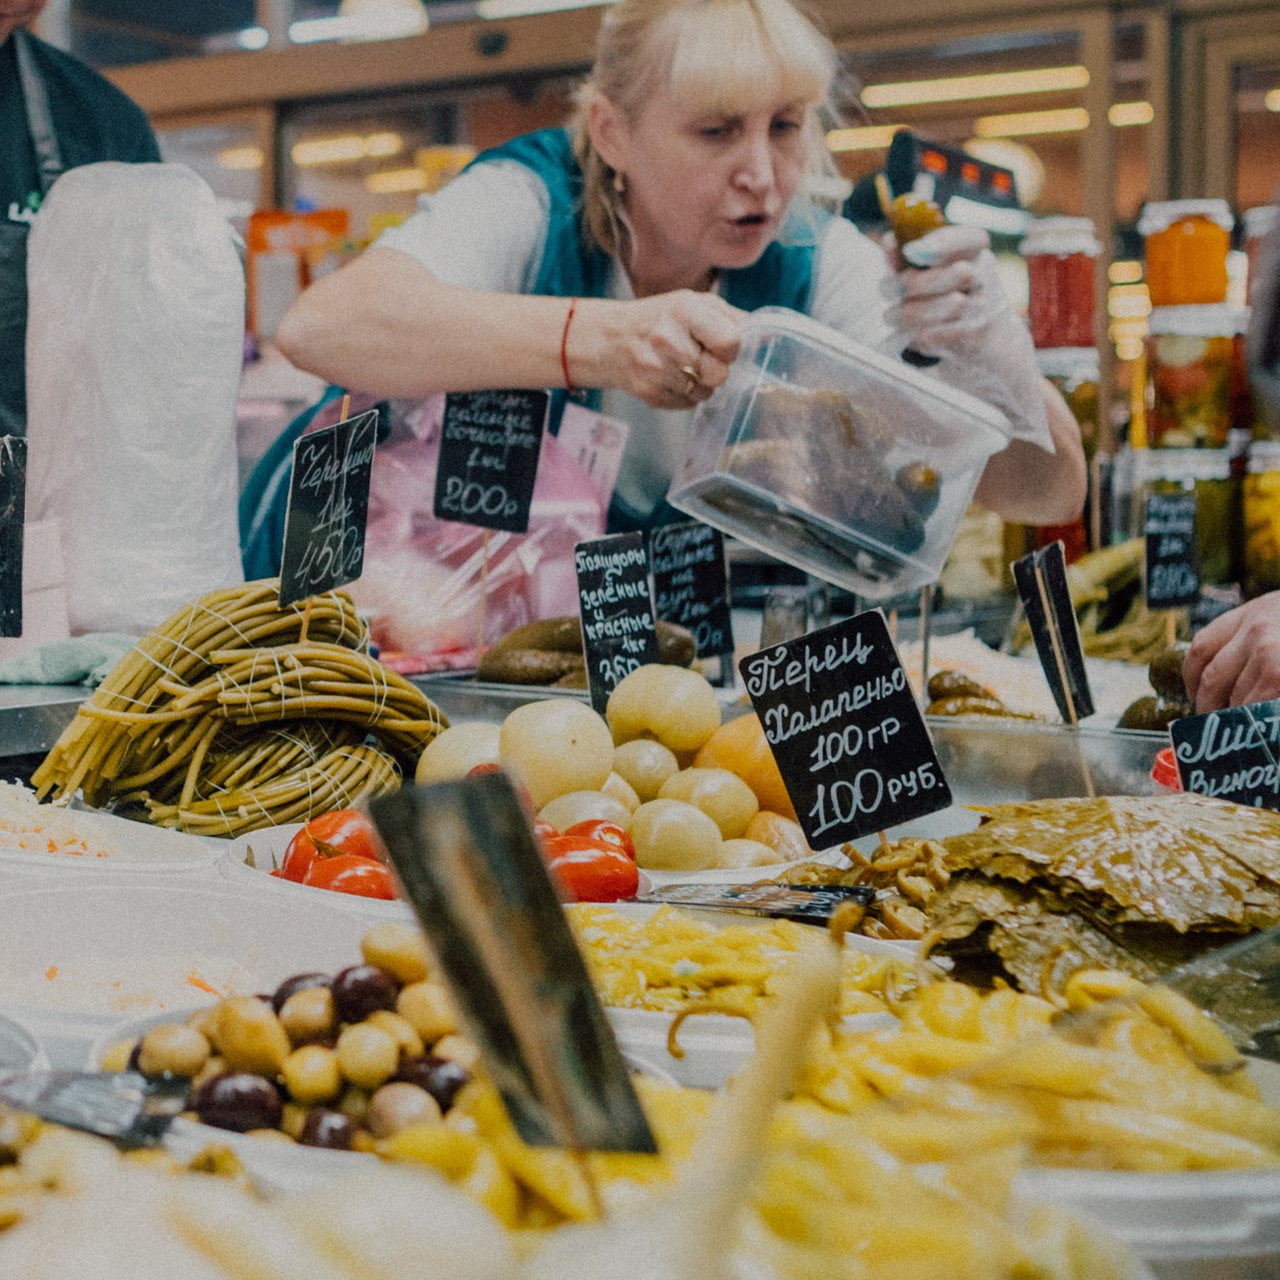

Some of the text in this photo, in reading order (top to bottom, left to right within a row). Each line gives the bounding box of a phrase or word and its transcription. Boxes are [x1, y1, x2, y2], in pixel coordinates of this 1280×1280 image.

[575, 548, 647, 581] Помидоры
[585, 612, 655, 640] красные
[593, 609, 605, 621] и
[748, 632, 875, 697] Перец
[766, 667, 907, 745] Халапеньо
